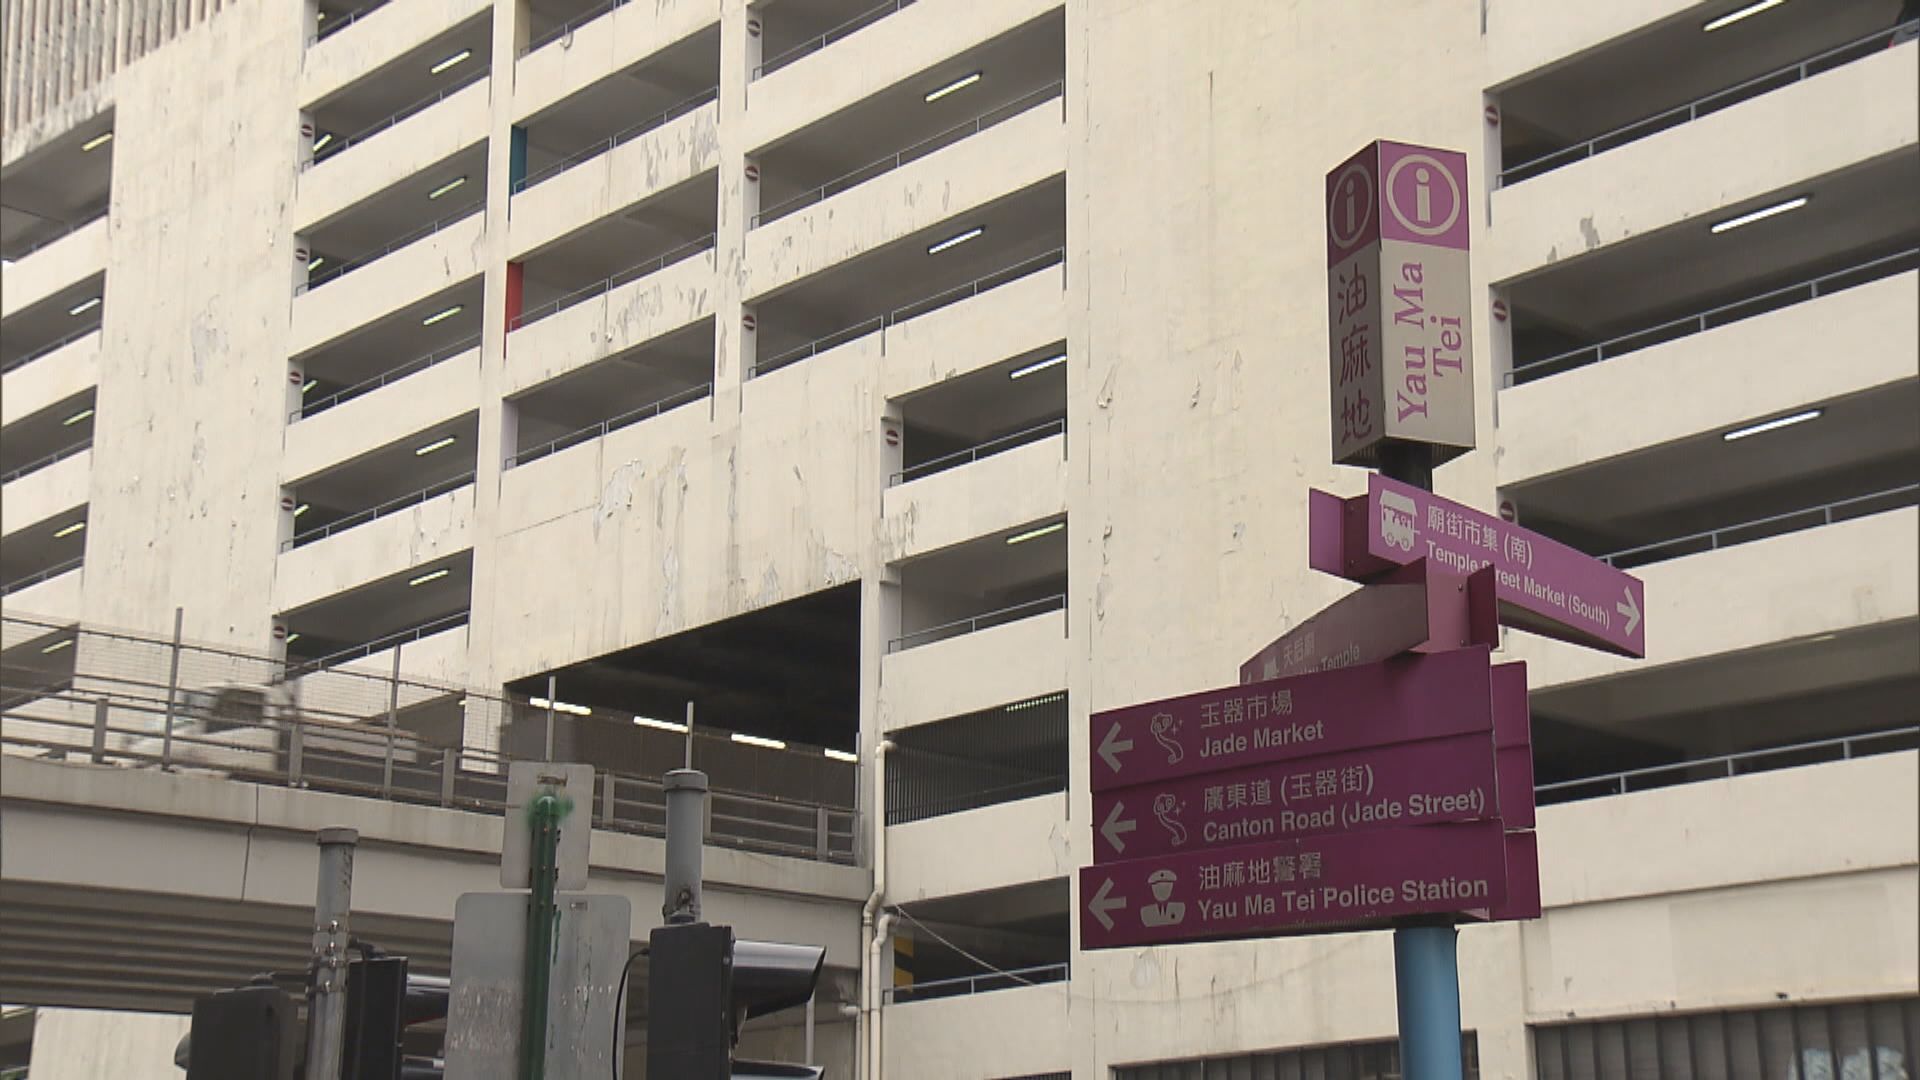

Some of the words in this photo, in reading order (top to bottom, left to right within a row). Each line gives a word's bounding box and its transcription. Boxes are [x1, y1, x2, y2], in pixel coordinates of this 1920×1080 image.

[1393, 262, 1425, 329] Ma
[1337, 262, 1372, 444] 油麻地
[1430, 315, 1463, 377] Tei
[1397, 346, 1428, 423] Yau
[1427, 504, 1498, 553] 廟街市集
[1504, 532, 1533, 571] (南)
[1426, 540, 1478, 574] Temple
[1524, 576, 1565, 609] Market
[1568, 594, 1610, 631] (South)
[1200, 689, 1293, 729] 玉器市場
[1200, 733, 1247, 758] Jade
[1253, 720, 1324, 749] Market
[1203, 817, 1274, 842] Canton
[1281, 805, 1335, 832] Road
[1341, 798, 1402, 829] (Jade
[1408, 787, 1485, 816] Street)
[1204, 779, 1272, 813] 廣東道
[1281, 763, 1374, 807] (玉器街)
[1198, 898, 1237, 921] Yau
[1245, 894, 1275, 916] Ma
[1281, 888, 1316, 913] Tei
[1323, 883, 1395, 909] Police
[1401, 876, 1488, 902] Station
[1199, 852, 1321, 892] 油麻地警署
